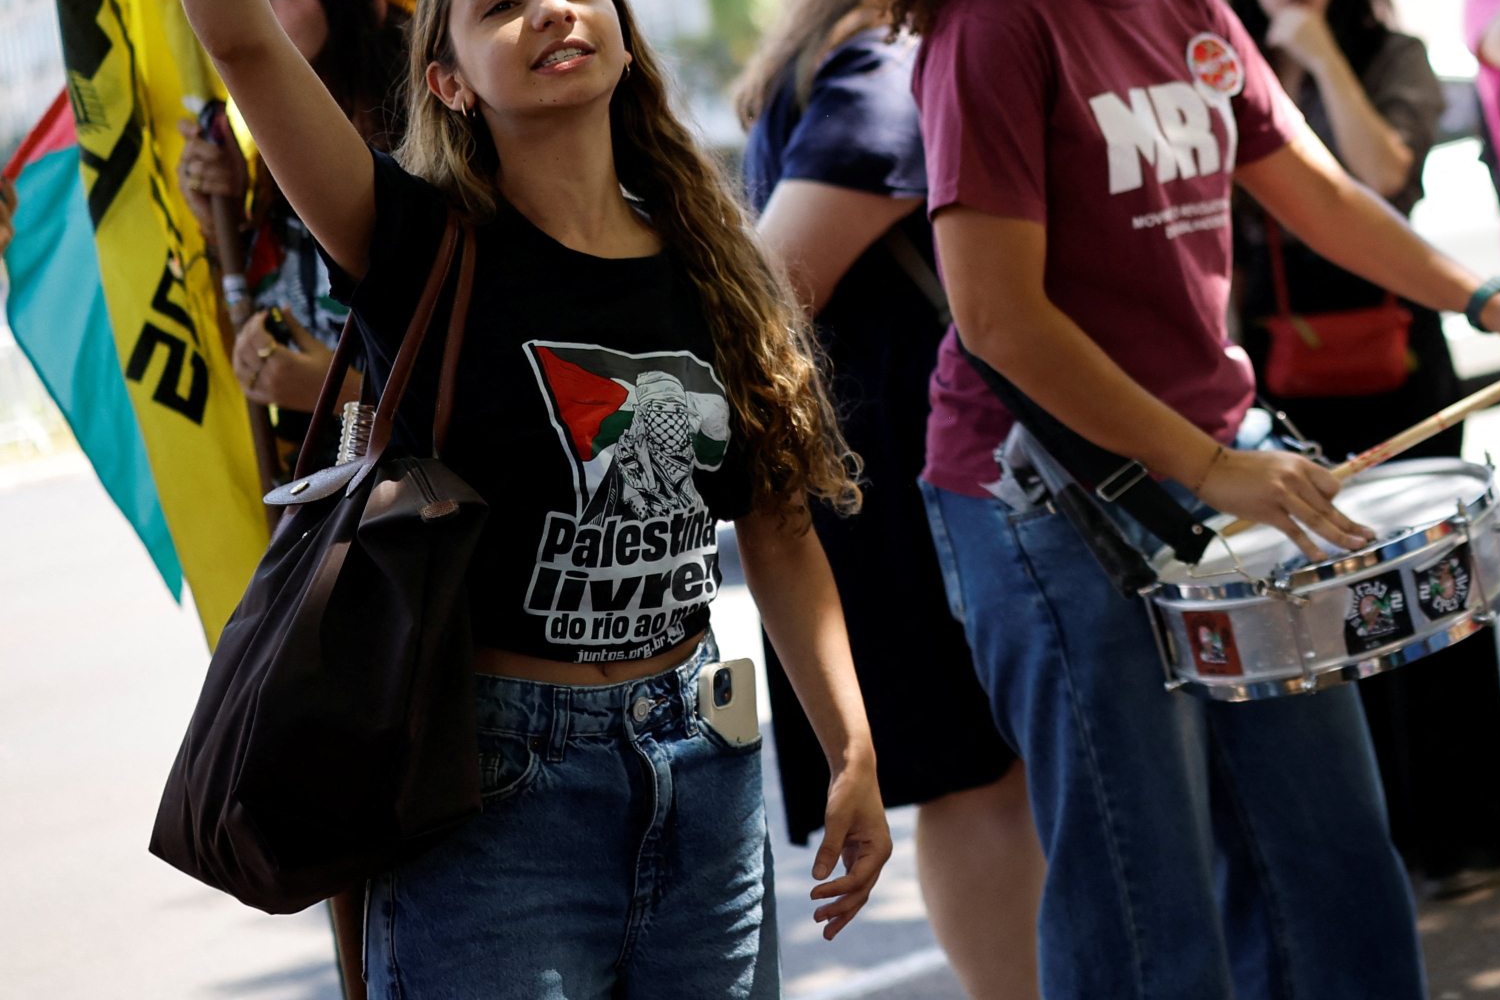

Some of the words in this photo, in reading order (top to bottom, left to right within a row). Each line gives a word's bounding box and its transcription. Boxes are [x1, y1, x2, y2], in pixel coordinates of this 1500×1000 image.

[541, 506, 716, 568] Palestina
[528, 553, 717, 612] livre!
[551, 613, 586, 640] do
[591, 612, 629, 640] rio
[634, 612, 667, 638] ao
[574, 635, 666, 663] juntos.org.br
